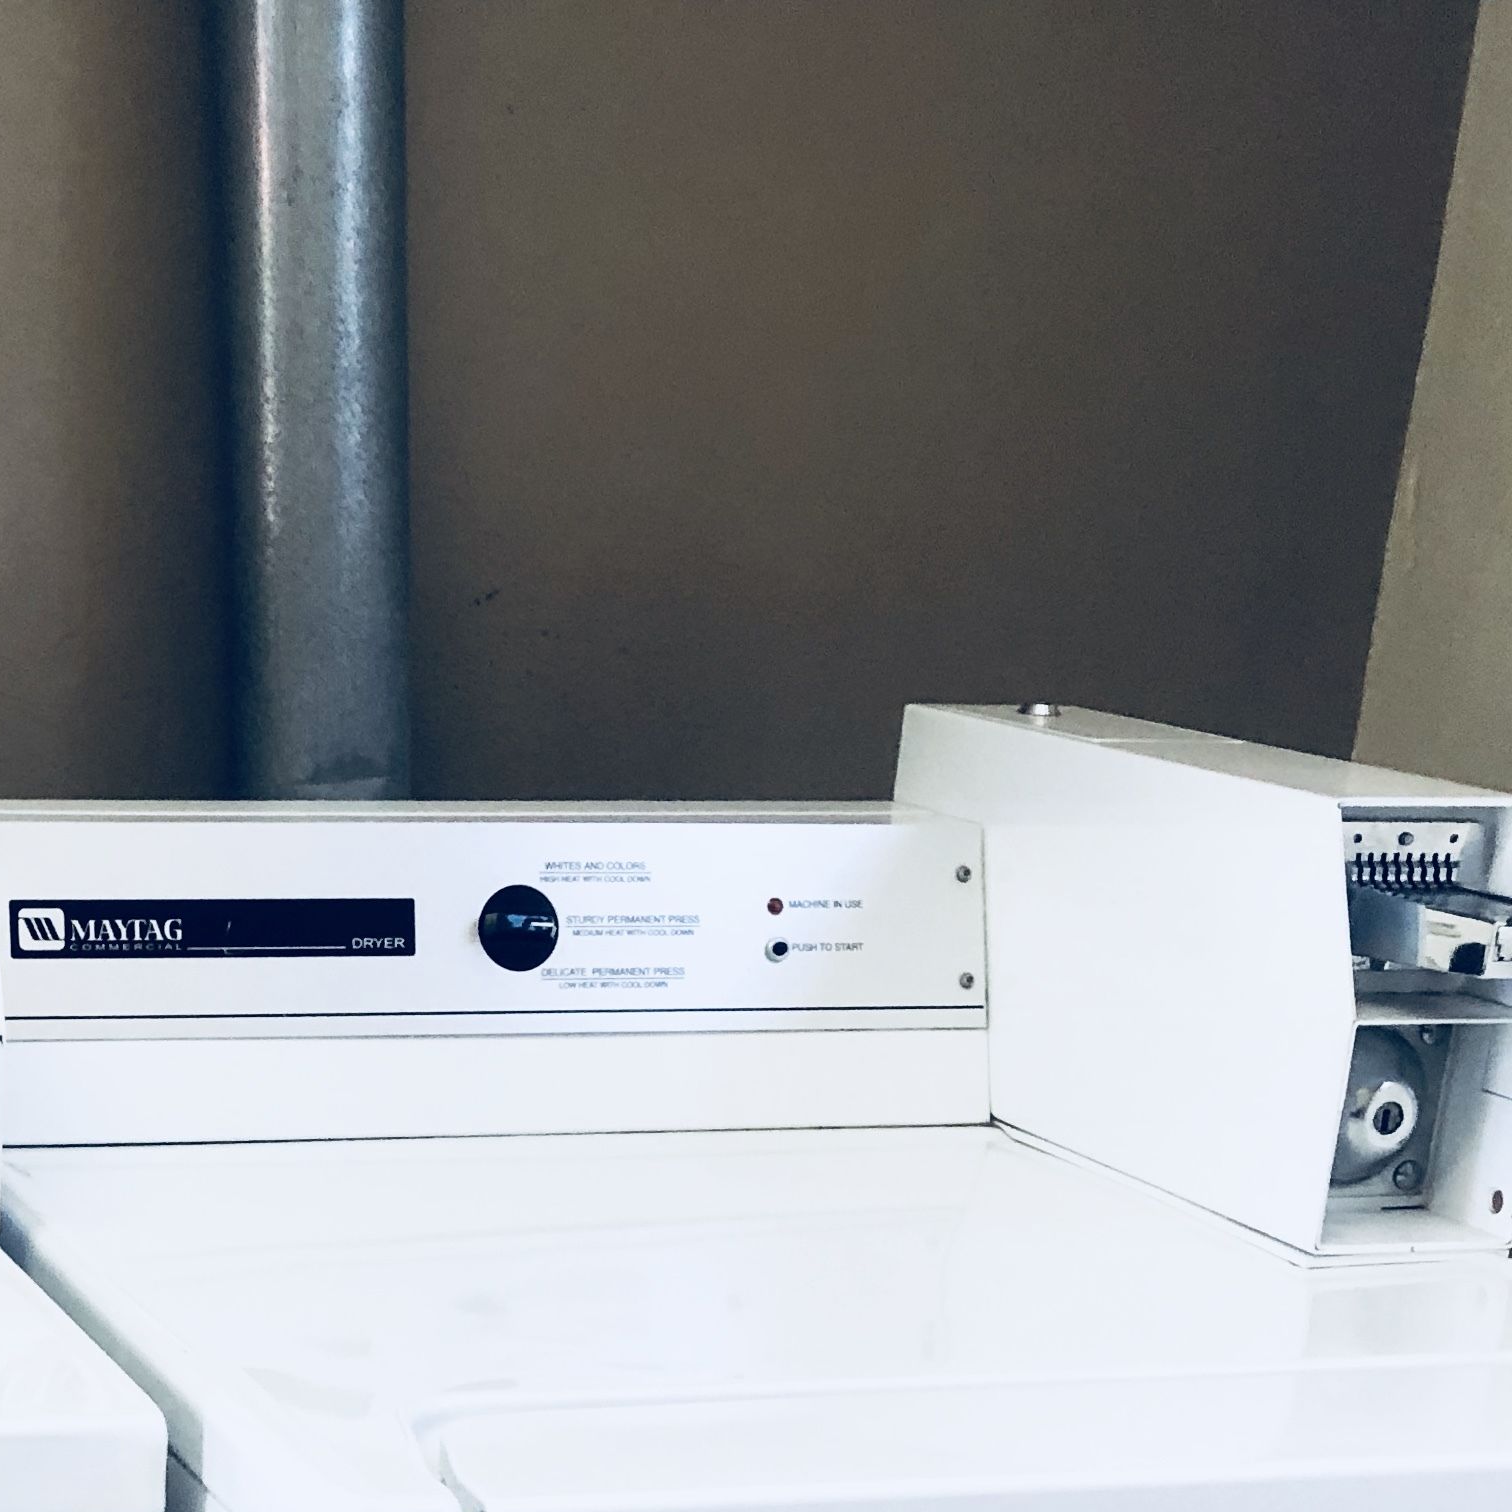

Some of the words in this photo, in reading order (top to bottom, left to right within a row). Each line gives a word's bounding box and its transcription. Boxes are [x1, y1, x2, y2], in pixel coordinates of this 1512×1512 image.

[545, 861, 582, 871] WHITES
[584, 861, 604, 871] AND
[606, 861, 647, 871] COLORS
[561, 875, 581, 883] HEAT
[583, 875, 602, 883] WITH
[604, 875, 625, 883] COOL
[627, 875, 651, 883] DOWN
[788, 900, 830, 908] MACHINE
[833, 900, 842, 908] IN
[845, 900, 863, 908] USE
[566, 915, 604, 924] STURDY
[607, 915, 666, 924] PERMANENT
[668, 915, 700, 924] PRESS
[70, 917, 183, 942] MAYTAG
[69, 942, 183, 951] COMMERCIAL
[351, 937, 405, 949] DRYER
[792, 943, 817, 951] PUSH
[820, 943, 833, 951] TO
[835, 943, 864, 951] START
[541, 968, 587, 977] DELICATE
[592, 967, 650, 976] PERMANENT
[654, 967, 685, 976] PRESS
[600, 981, 619, 989] WITH
